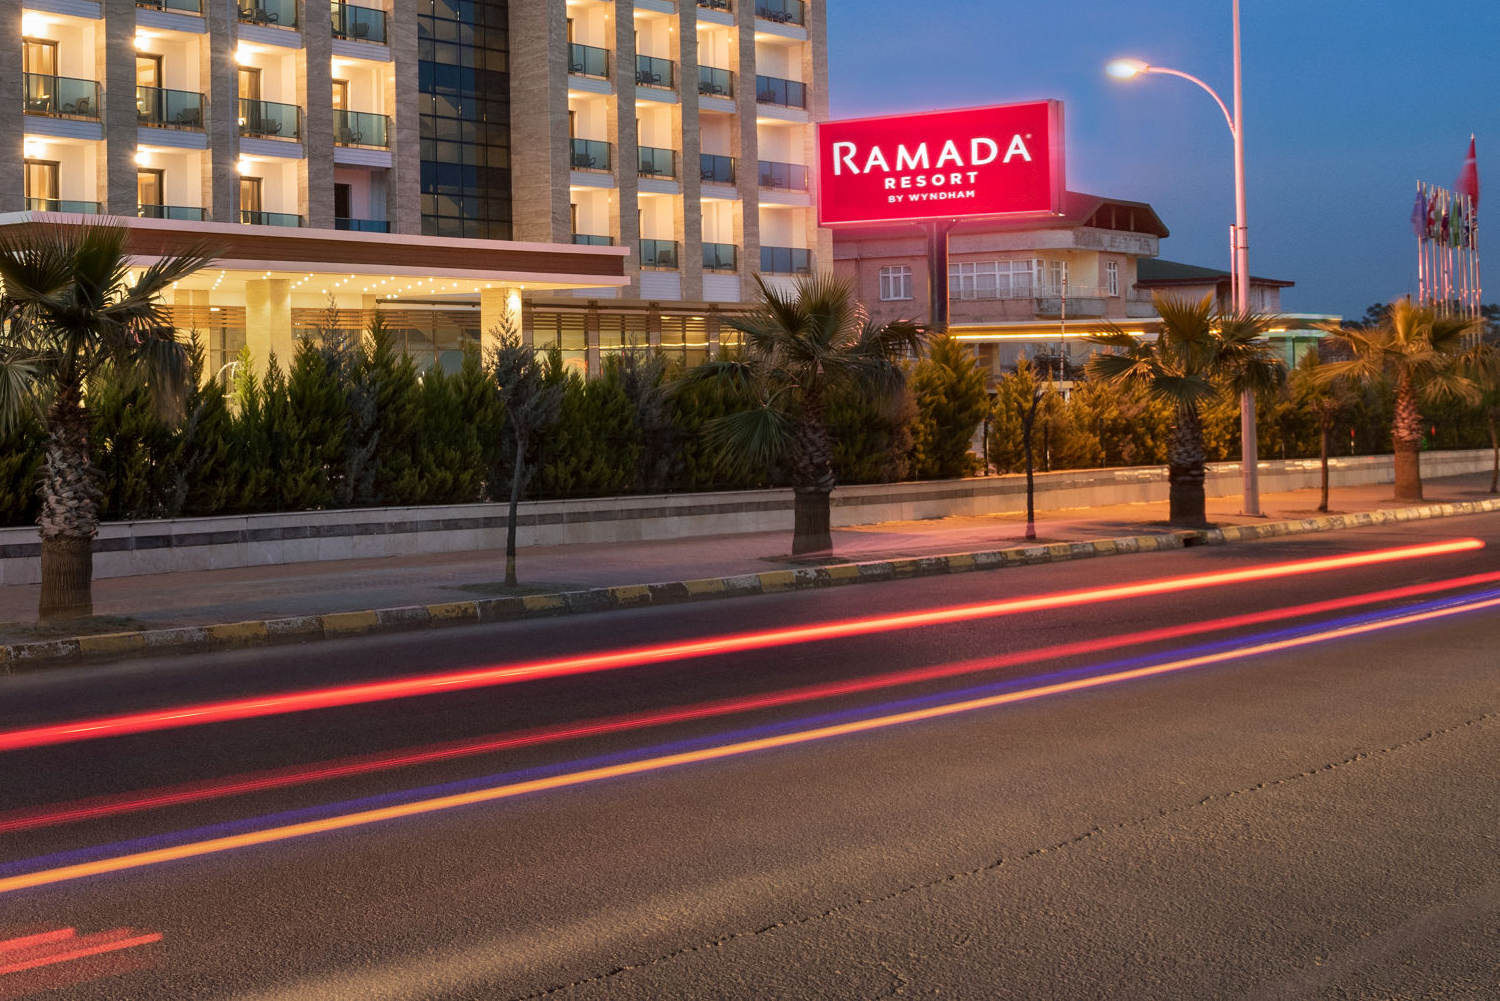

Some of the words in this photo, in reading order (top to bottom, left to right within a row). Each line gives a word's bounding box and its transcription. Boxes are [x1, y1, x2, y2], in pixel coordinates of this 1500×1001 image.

[833, 134, 1032, 176] RAMADA
[884, 171, 978, 189] RESORT
[888, 194, 904, 203] BY
[909, 190, 975, 202] WYNDHAM
